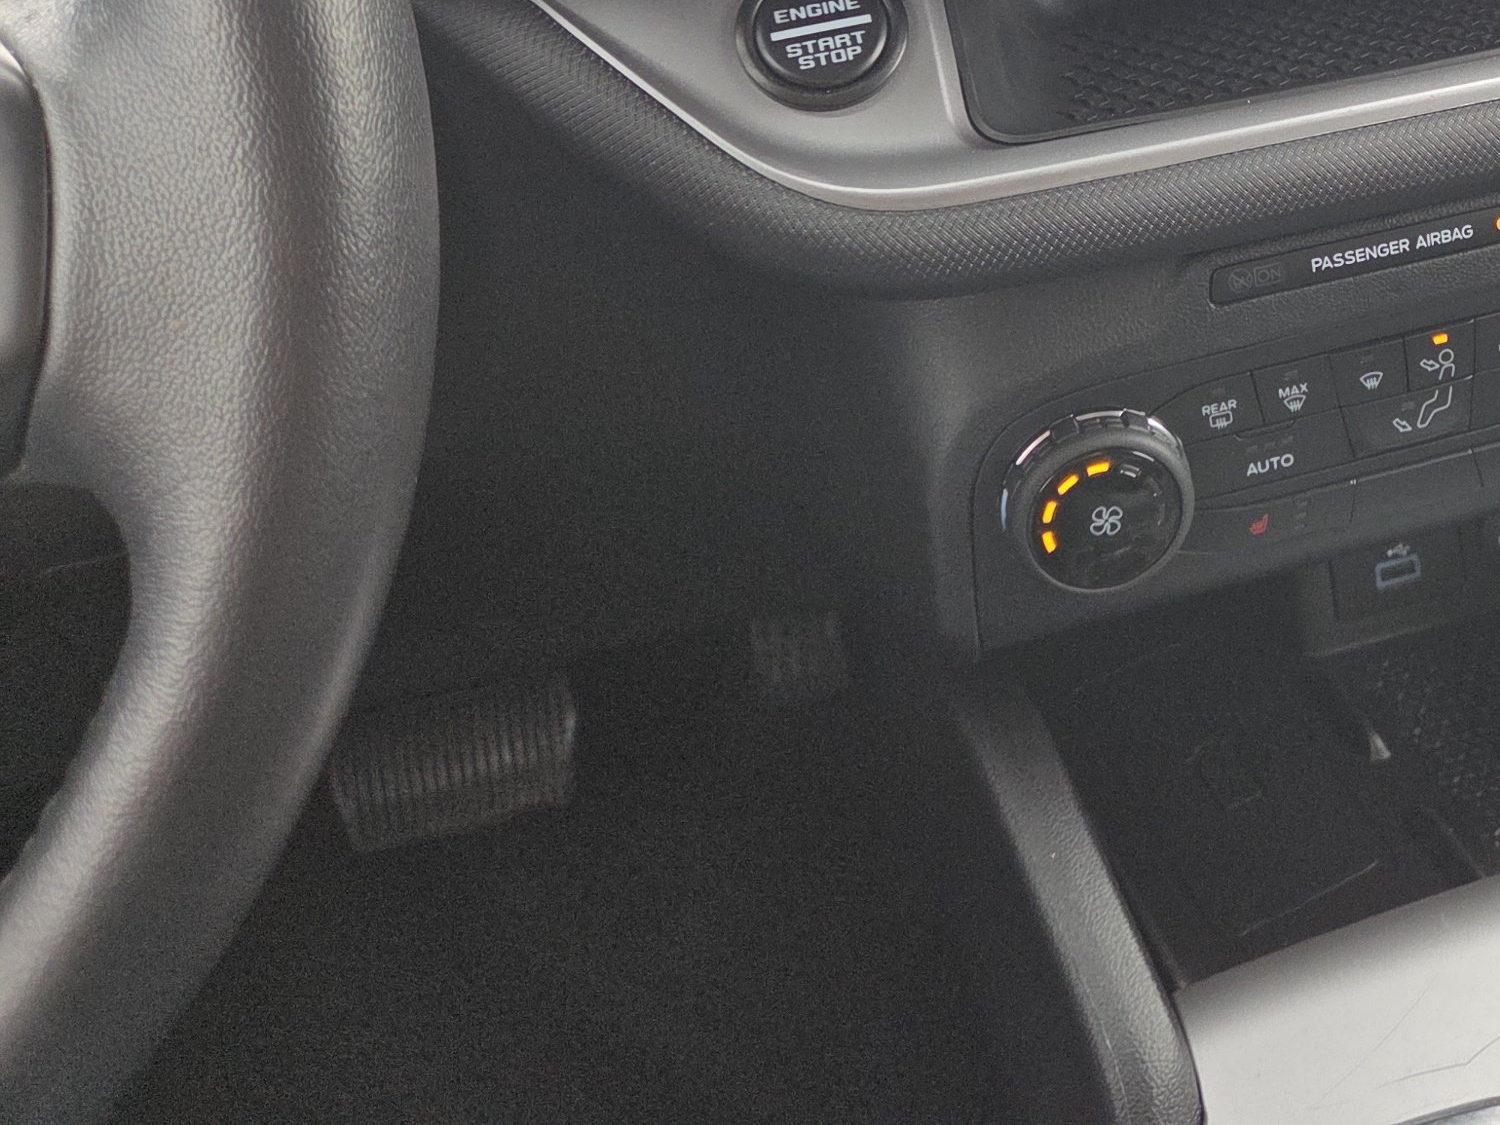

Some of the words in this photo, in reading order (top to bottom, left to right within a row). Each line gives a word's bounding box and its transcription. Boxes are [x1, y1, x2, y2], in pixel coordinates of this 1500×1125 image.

[785, 30, 866, 59] START
[798, 45, 863, 70] STOP
[1310, 238, 1410, 273] PASSENGER
[1415, 223, 1474, 251] AIRBAG
[1278, 382, 1308, 399] MAX
[1201, 399, 1238, 417] REAR
[1246, 453, 1295, 477] AUTO
